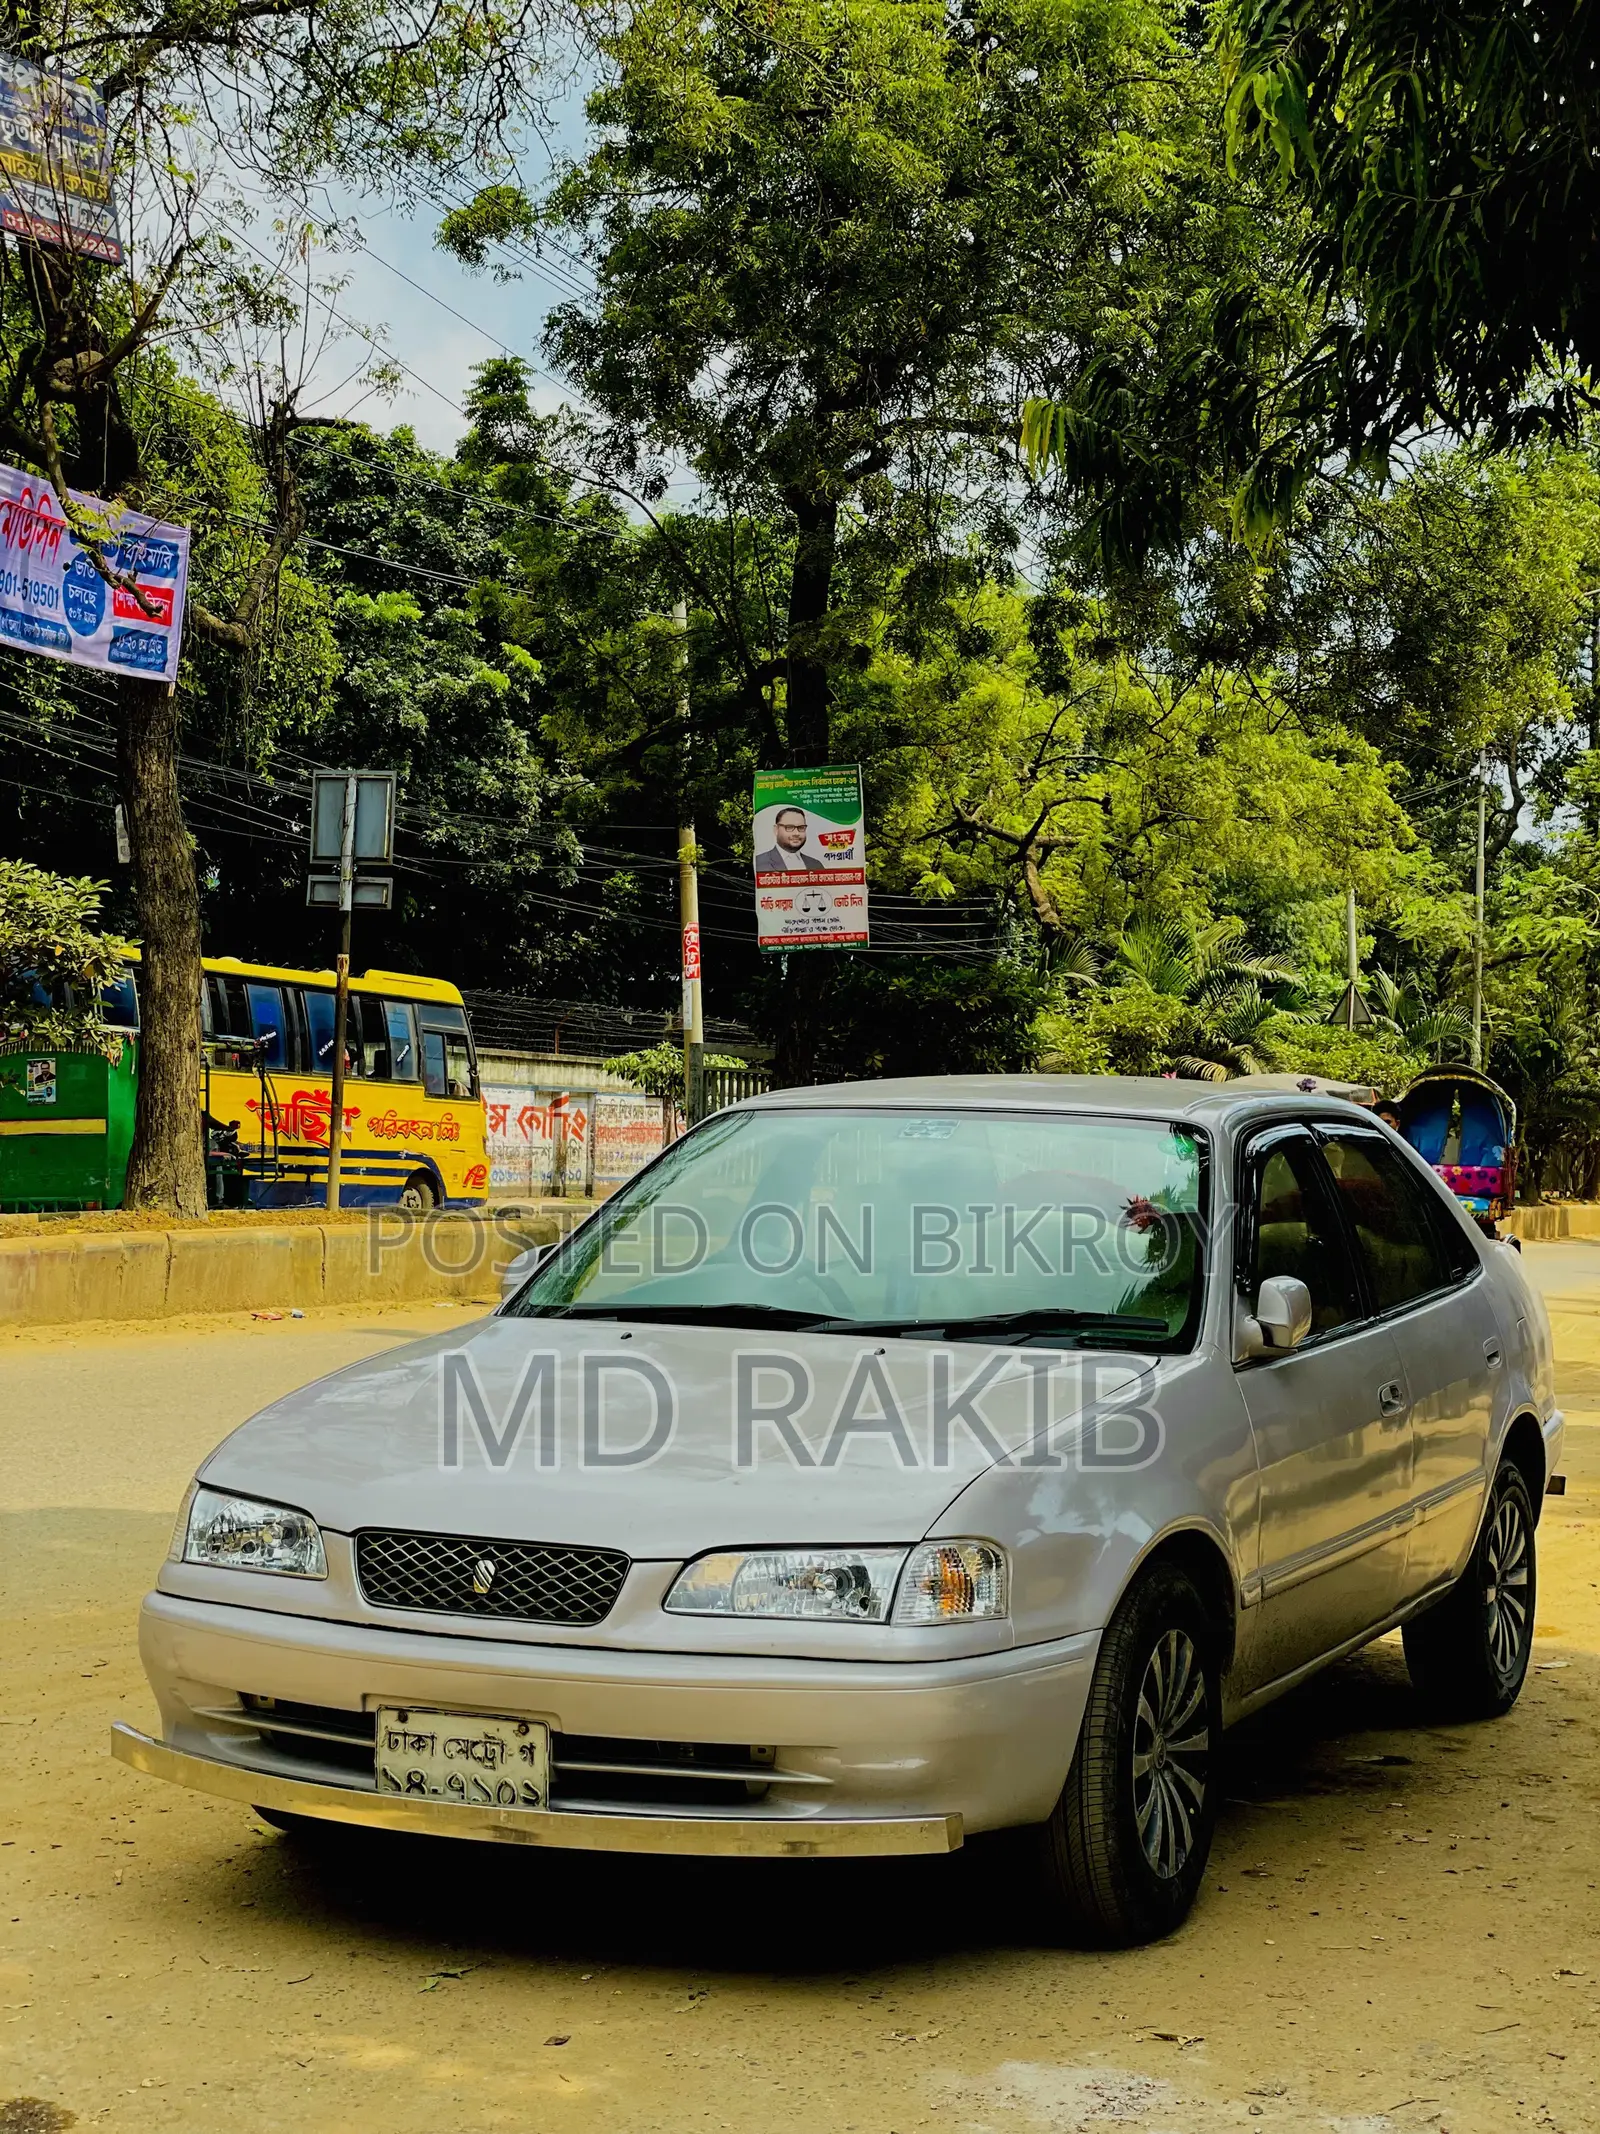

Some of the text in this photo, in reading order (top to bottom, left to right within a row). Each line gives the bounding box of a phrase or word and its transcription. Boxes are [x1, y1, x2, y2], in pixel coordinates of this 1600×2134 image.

[68, 584, 97, 609] চলছে
[834, 893, 863, 908] ভোট দিন
[367, 1109, 434, 1140] পরিবহন
[386, 1728, 438, 1758] ঢাকা
